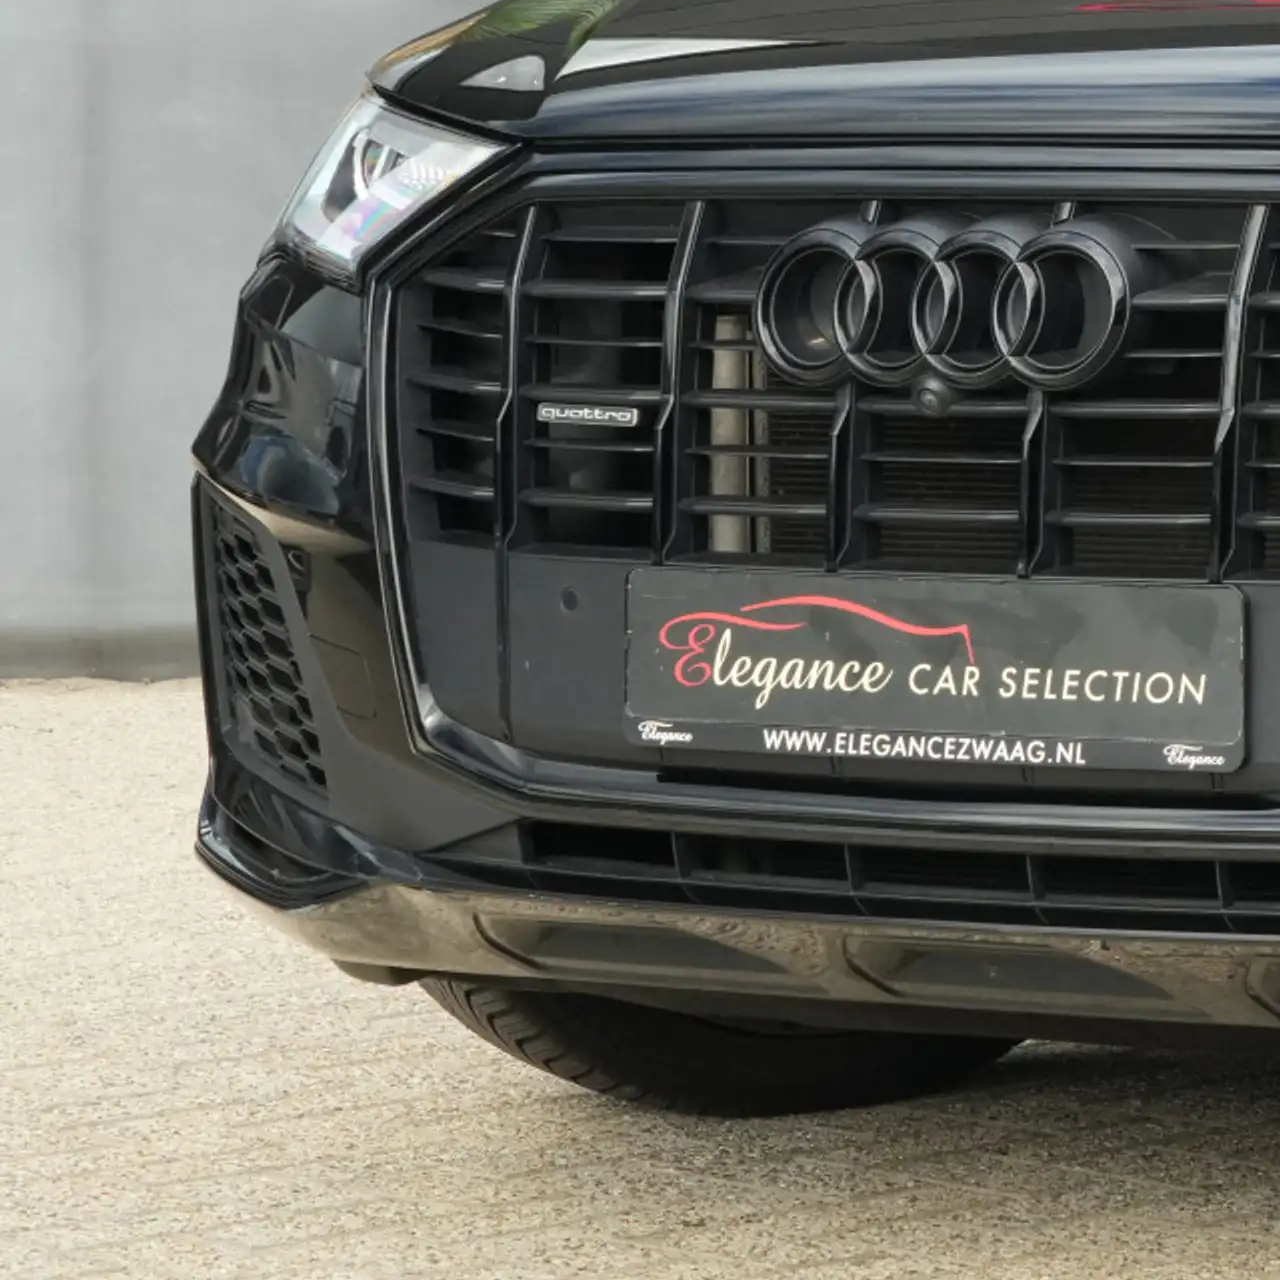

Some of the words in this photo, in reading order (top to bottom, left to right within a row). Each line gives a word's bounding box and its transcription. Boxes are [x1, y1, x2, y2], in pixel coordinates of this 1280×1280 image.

[541, 407, 632, 421] quattro
[659, 611, 894, 710] Elegance
[907, 662, 980, 697] CAR
[997, 665, 1207, 705] SELECTION
[638, 720, 694, 745] Elegance
[762, 728, 1086, 766] WWW.ELEGANCEZWAAG.NL
[1163, 743, 1227, 771] Elegance
